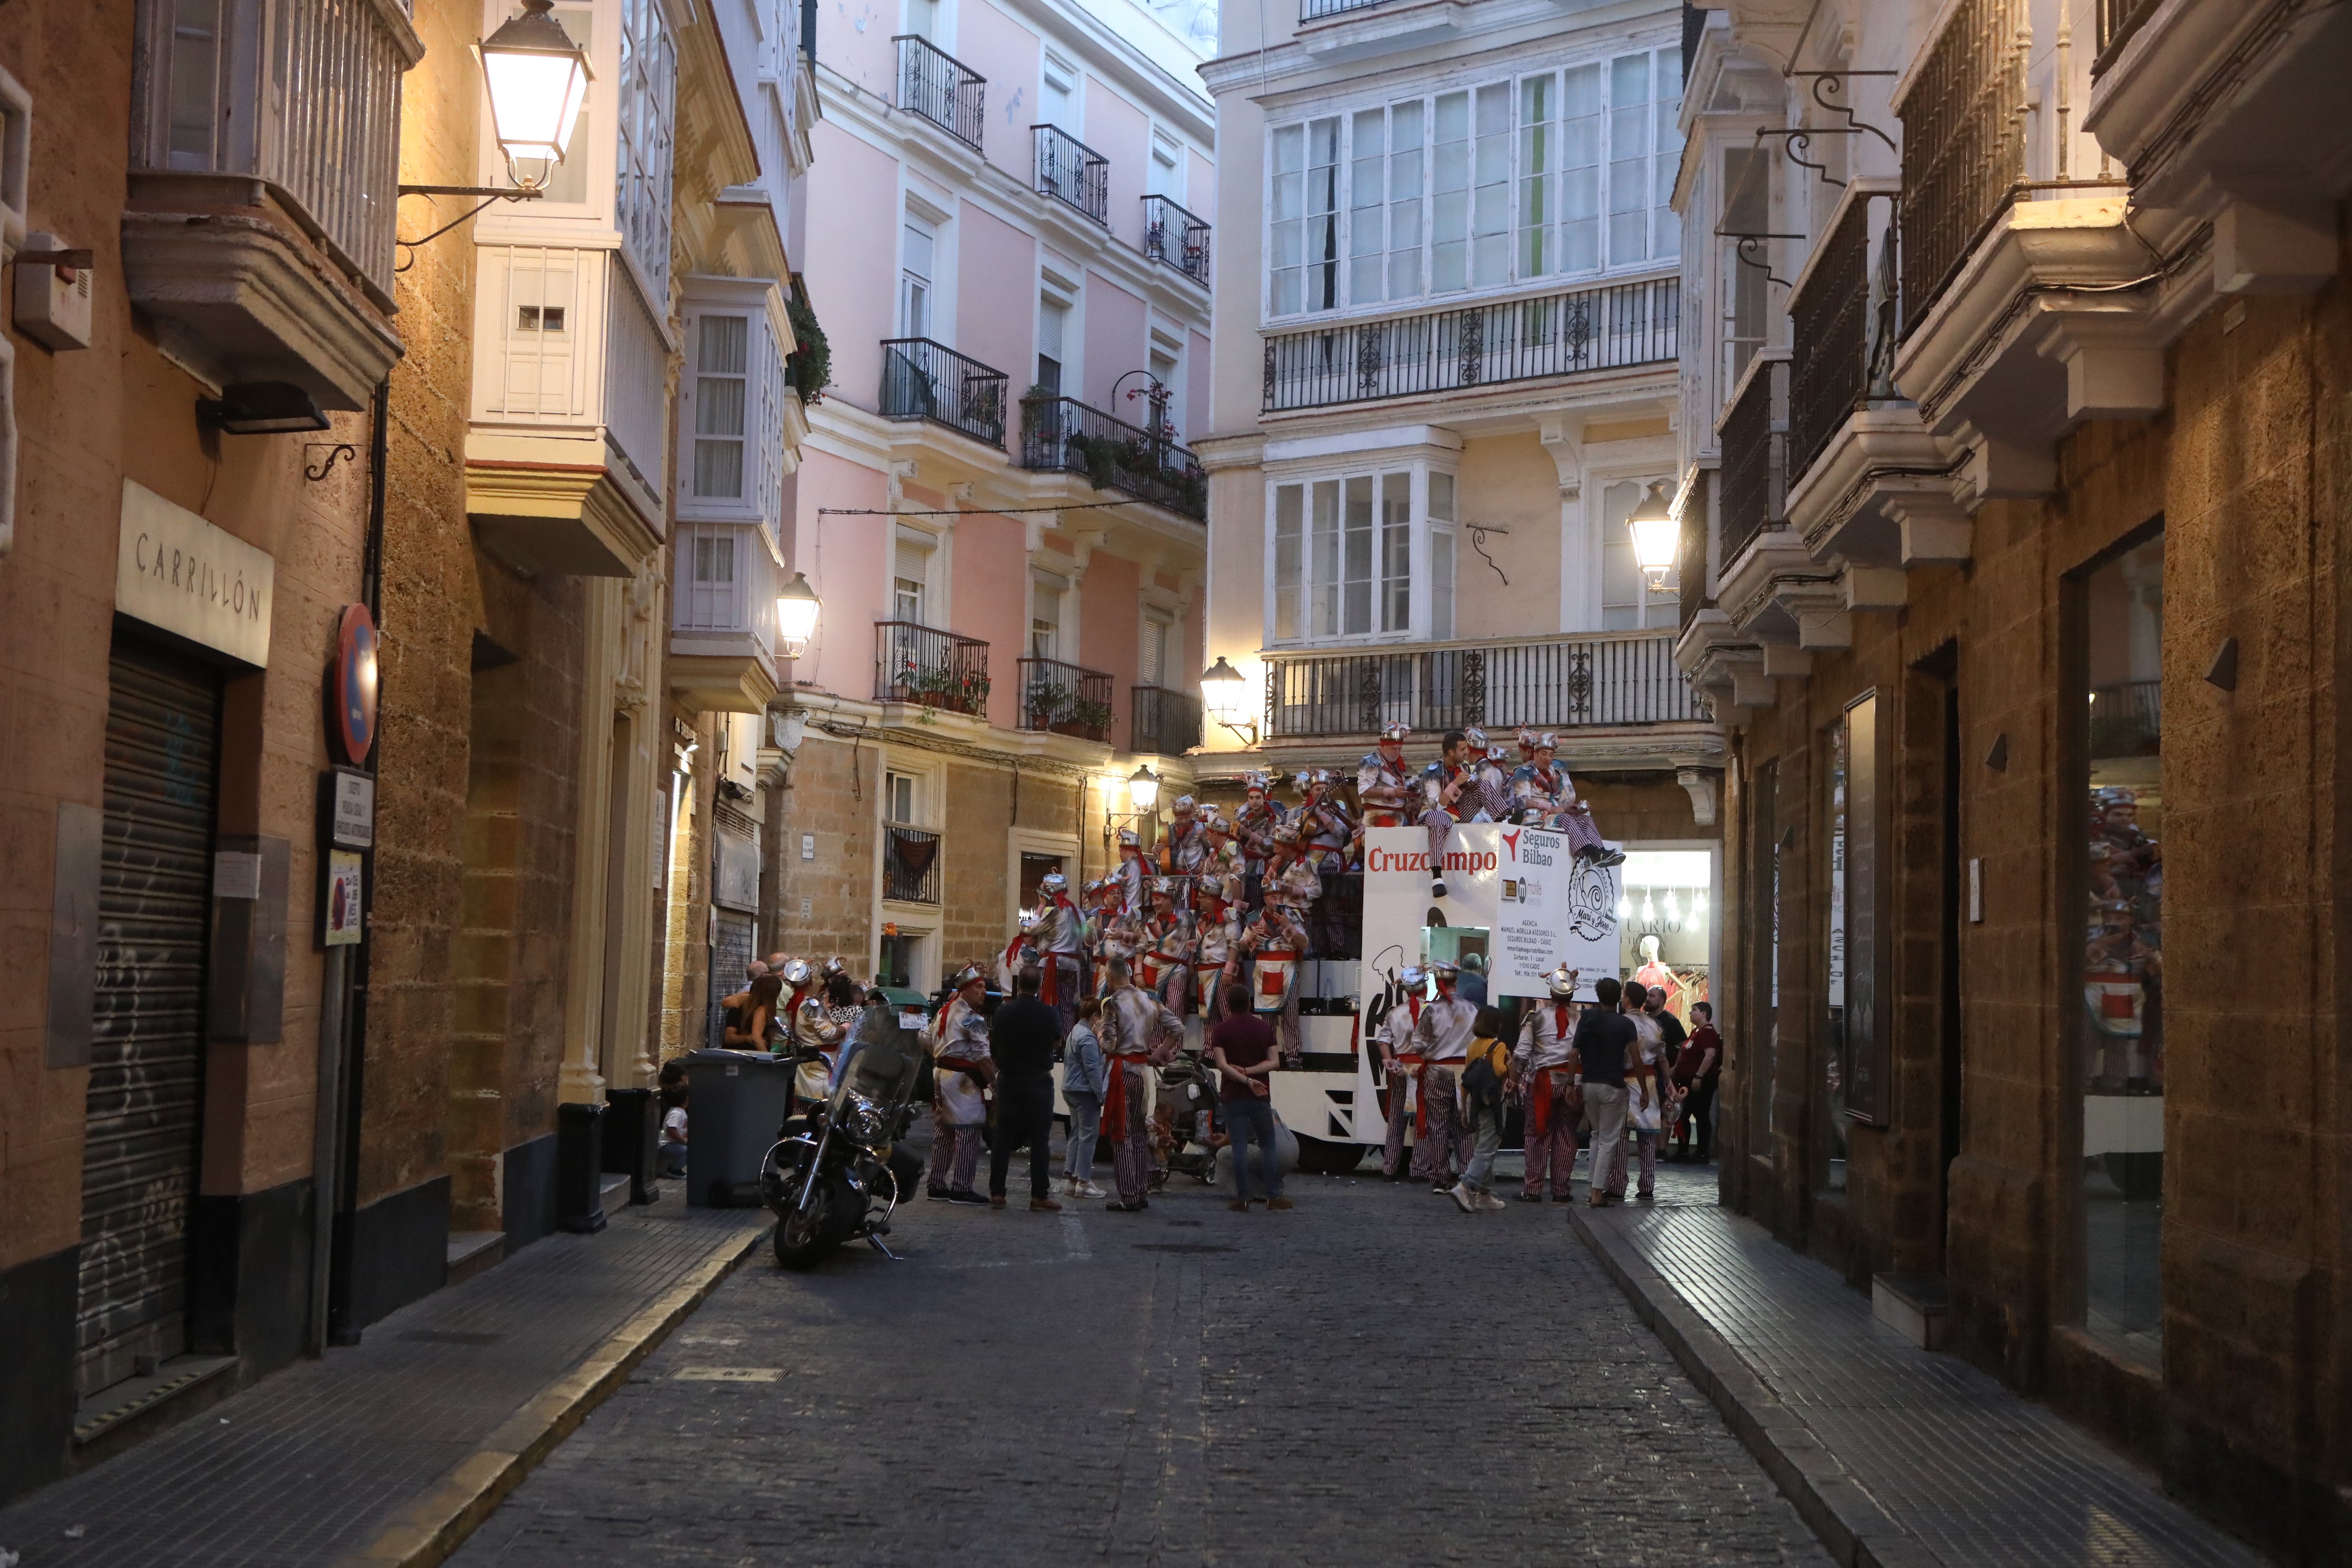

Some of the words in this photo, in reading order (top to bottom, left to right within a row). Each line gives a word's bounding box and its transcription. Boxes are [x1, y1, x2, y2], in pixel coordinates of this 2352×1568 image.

[136, 533, 260, 622] CARRILLÓN
[1523, 830, 1560, 849] Seguros
[1368, 846, 1497, 875] Cruzcmpo
[1523, 849, 1552, 867] Bilbao
[1575, 909, 1592, 922] Mari
[1592, 917, 1595, 926] y
[1595, 916, 1610, 931] Jose
[1623, 918, 1681, 933] UARIO
[1507, 946, 1553, 955] mmorilla@segurosbilbao.com
